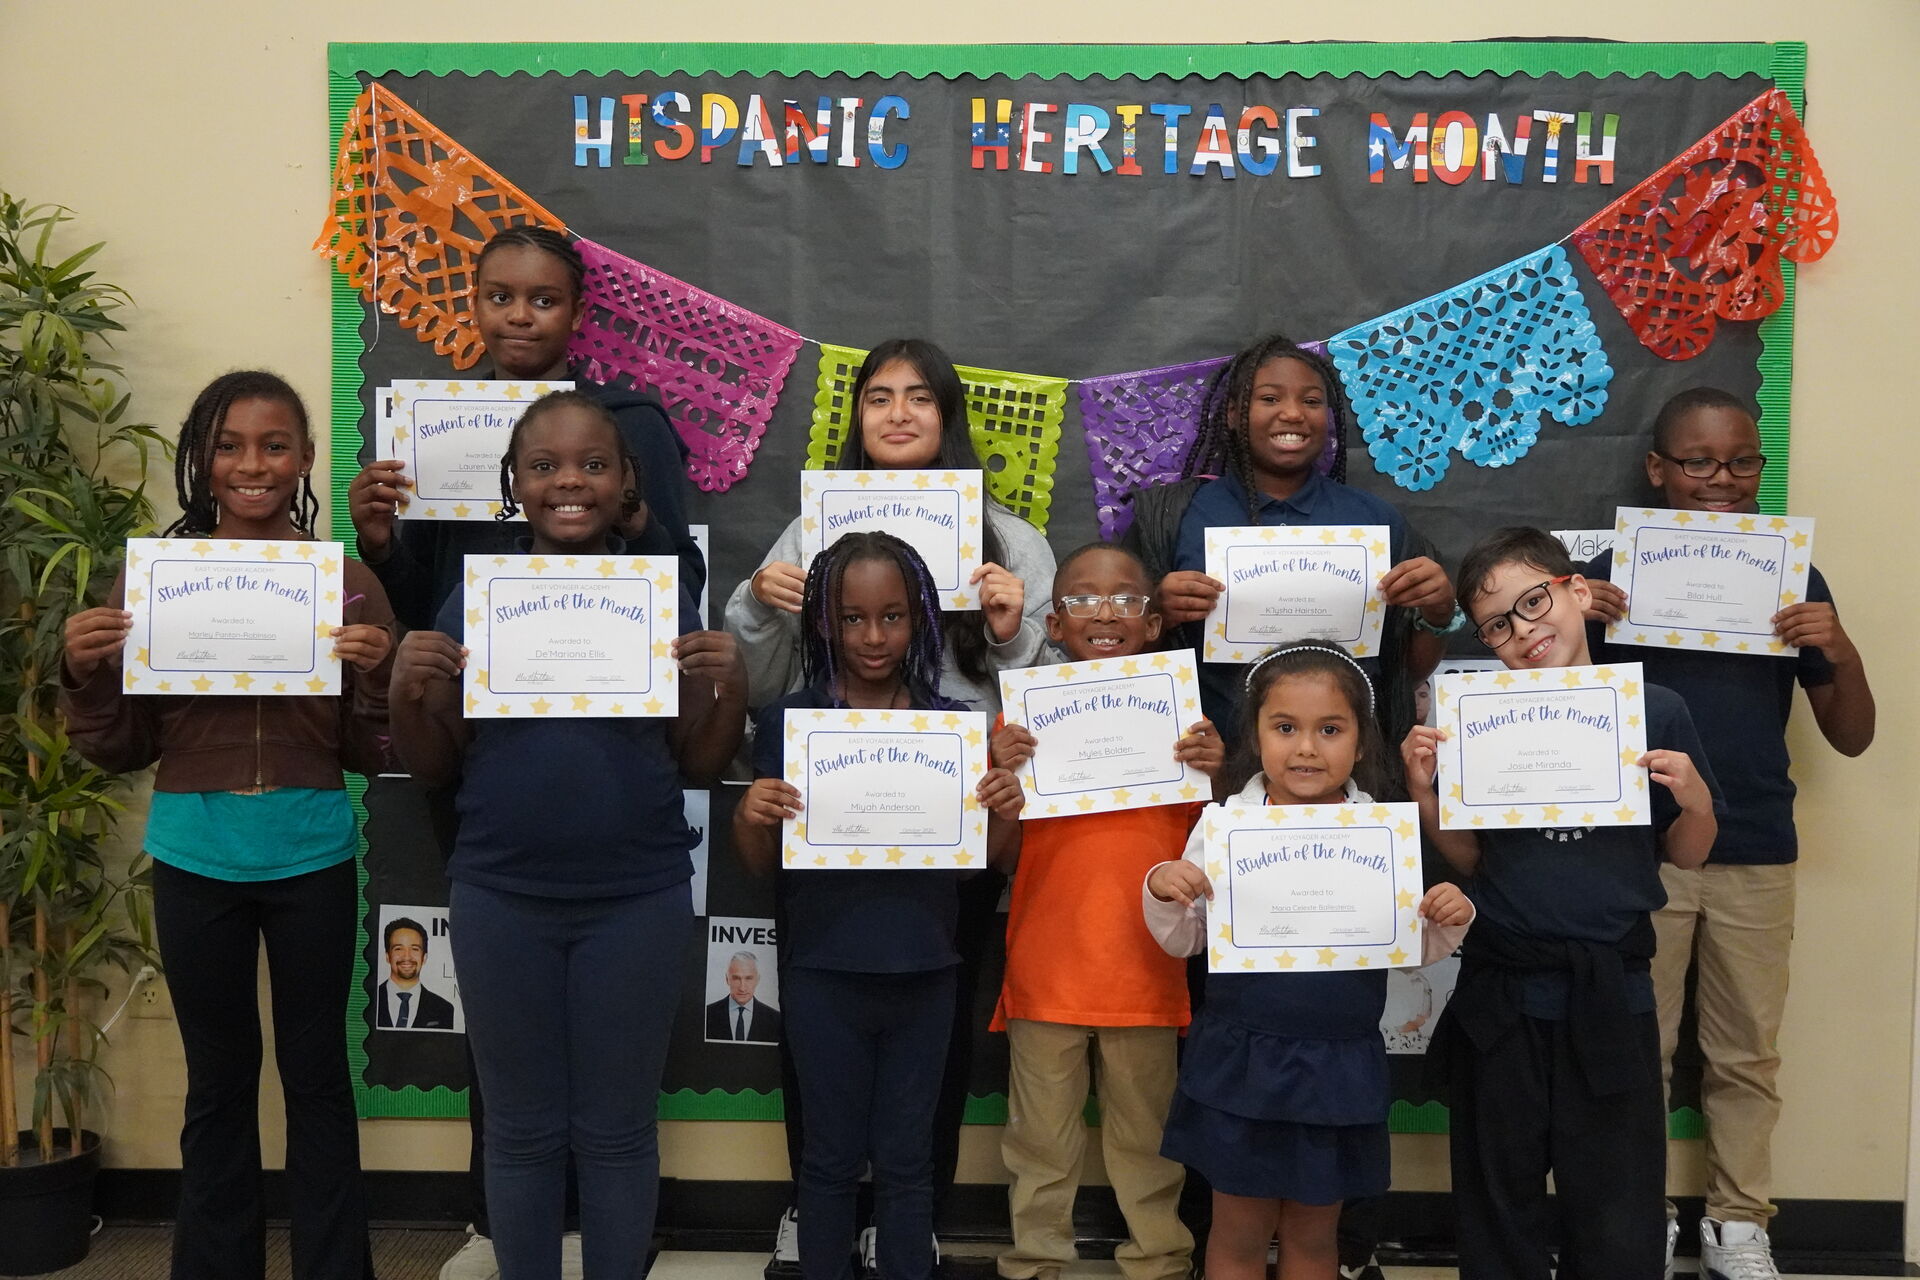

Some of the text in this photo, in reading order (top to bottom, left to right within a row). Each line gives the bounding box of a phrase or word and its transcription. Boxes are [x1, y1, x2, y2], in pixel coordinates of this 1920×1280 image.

[573, 91, 1620, 185] HISPANIC HERITAGE MONTH
[608, 310, 726, 379] CINCO
[419, 415, 466, 439] Student
[468, 414, 481, 428] of
[484, 413, 504, 428] the
[828, 503, 955, 530] Student of the Month
[1560, 534, 1614, 556] Mak
[1233, 557, 1364, 585] Student of the Month
[1640, 544, 1778, 576] Student of the Month
[158, 575, 311, 606] Student of the Month
[1686, 581, 1717, 590] Awarded
[495, 593, 647, 624] Student of the Month
[211, 617, 244, 625] Awarded
[189, 631, 214, 639] Marley
[589, 650, 606, 658] Ellis
[1079, 687, 1106, 695] VOYAGER
[1107, 683, 1136, 692] ACADEMY
[1033, 693, 1172, 731] Student of the Month
[1466, 705, 1613, 739] Student of the Month
[1084, 737, 1115, 745] Awarded
[814, 746, 958, 778] Student of the Month
[1078, 746, 1133, 759] Myles Bolden
[1535, 761, 1572, 769] Miranda
[851, 803, 920, 813] Miyah Anderson
[1271, 834, 1288, 842] EAST
[1320, 833, 1351, 841] ACADEMY
[1236, 843, 1389, 876] Student of the Month
[1291, 889, 1324, 897] Awarded
[711, 925, 777, 945] INVES
